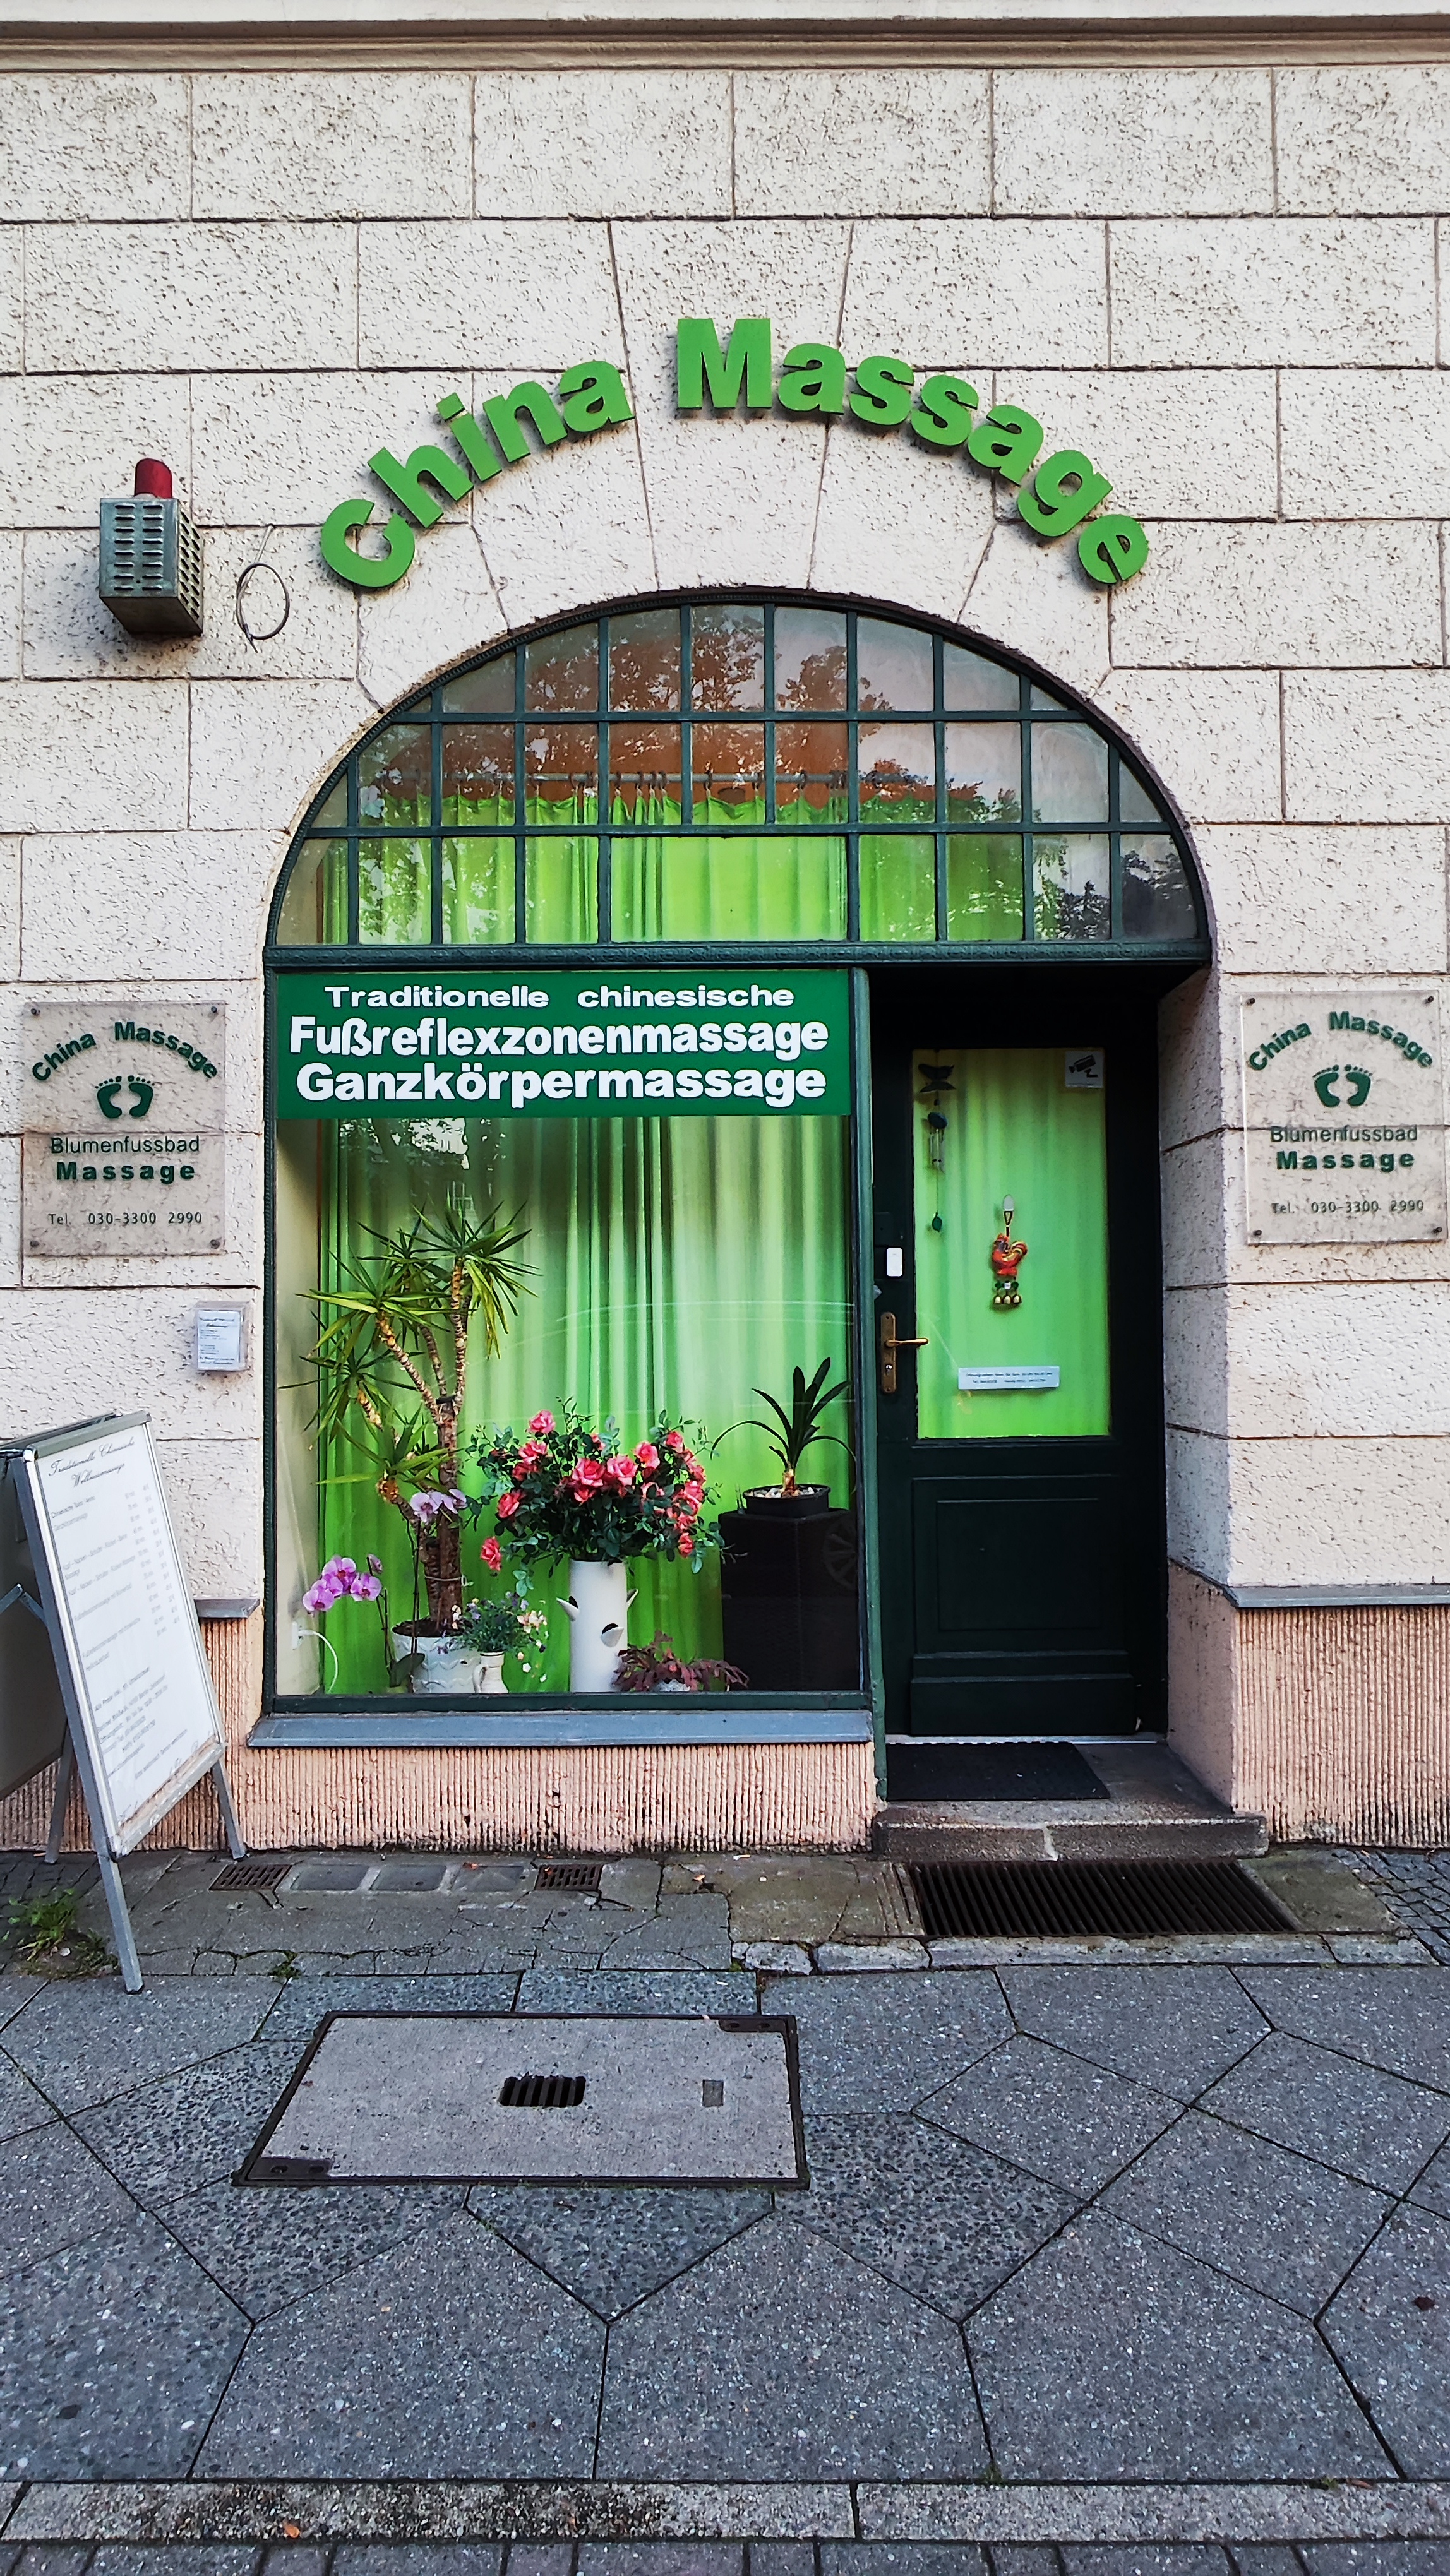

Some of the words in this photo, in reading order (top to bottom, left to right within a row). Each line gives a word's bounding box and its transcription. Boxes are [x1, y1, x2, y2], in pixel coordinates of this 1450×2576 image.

[320, 360, 634, 588] China
[677, 318, 1149, 585] Massage
[325, 986, 549, 1008] Traditionelle
[577, 984, 794, 1008] chinesische
[290, 1016, 829, 1061] Fußreflexzonenmassage
[1249, 1022, 1313, 1071] China
[1329, 1010, 1434, 1070] Massage
[32, 1032, 97, 1082] China
[114, 1020, 219, 1080] Massage
[296, 1062, 827, 1109] Ganzkörpermassage
[51, 1135, 200, 1155] Blumenfussbad
[1270, 1124, 1418, 1143] Blumenfussbad
[56, 1160, 196, 1185] Massage
[1276, 1150, 1415, 1172] Massage
[48, 1213, 71, 1226] Tel.
[88, 1212, 157, 1227] 030-3300
[167, 1211, 203, 1225] 2990
[1271, 1202, 1295, 1215] Tel.
[1310, 1200, 1381, 1214] 030-3300
[1391, 1199, 1425, 1213] 2990
